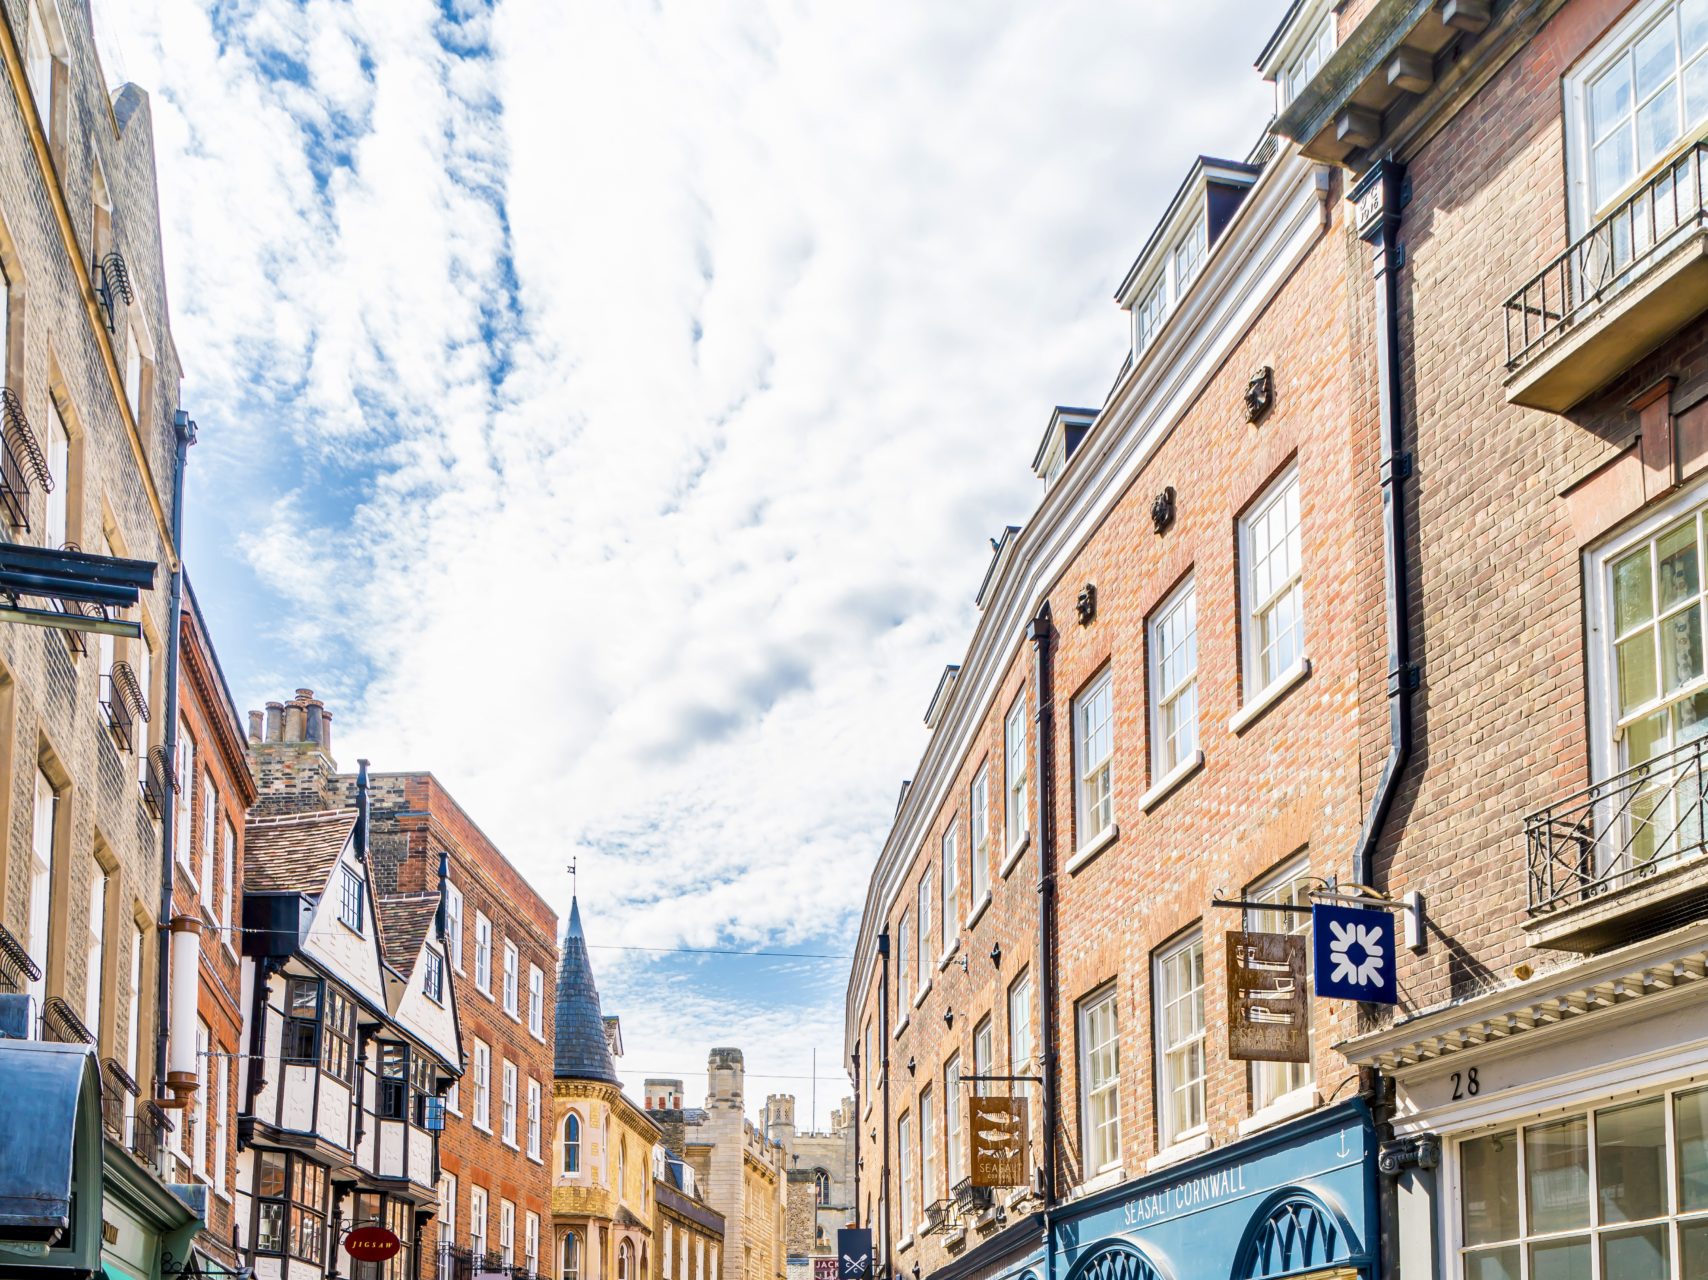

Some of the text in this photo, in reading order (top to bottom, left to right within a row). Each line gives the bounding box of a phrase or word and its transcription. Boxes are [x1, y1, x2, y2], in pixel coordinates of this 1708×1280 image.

[1450, 1067, 1480, 1101] 28
[1124, 1164, 1246, 1226] SEASALT CORNWALL
[352, 1241, 393, 1249] JIGSAW
